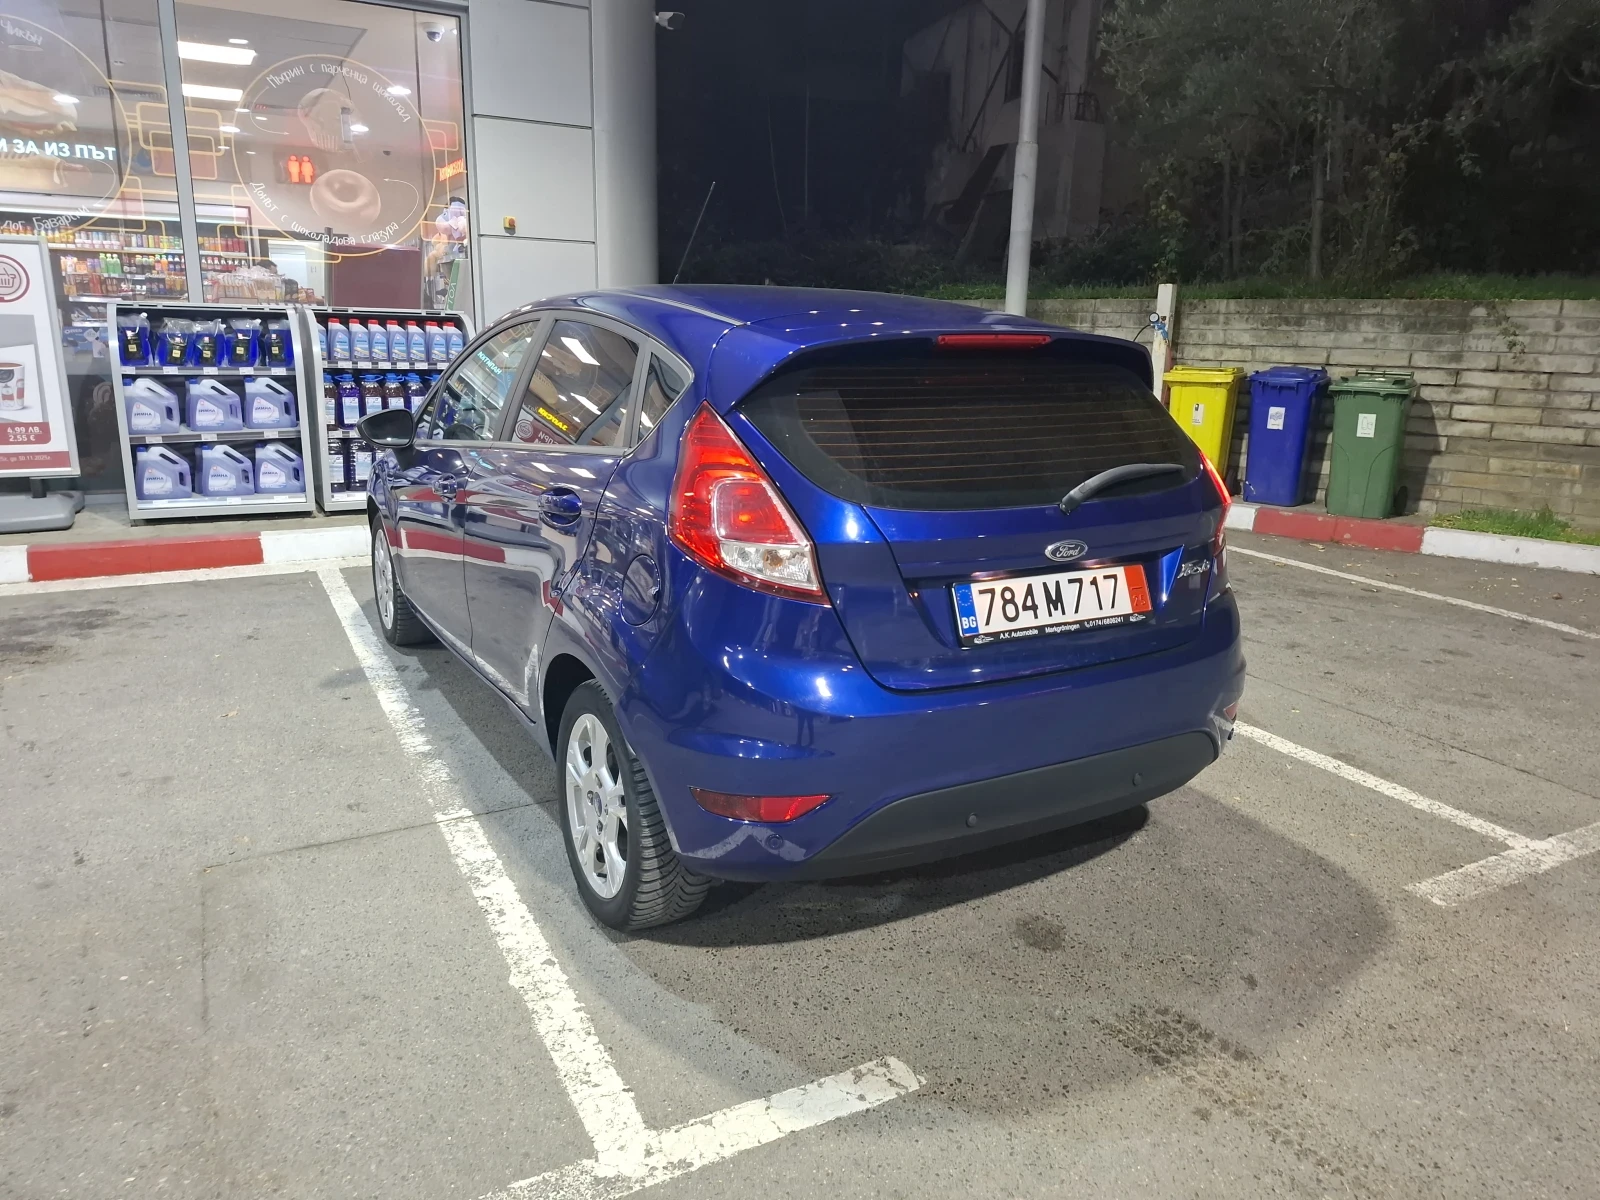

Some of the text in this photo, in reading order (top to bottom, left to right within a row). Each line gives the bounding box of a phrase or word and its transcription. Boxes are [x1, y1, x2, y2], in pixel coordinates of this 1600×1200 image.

[266, 64, 305, 88] Мъфин
[310, 63, 316, 73] с
[321, 63, 368, 84] парченца
[12, 139, 40, 154] ЗА
[44, 141, 71, 157] ИЗ
[75, 144, 117, 160] ПЪТ
[250, 181, 279, 212] Донът
[280, 214, 289, 222] с
[291, 221, 356, 246] шоколадова
[7, 426, 26, 434] 4.99
[9, 434, 36, 442] 2.55 €
[1056, 544, 1080, 557] Ford
[977, 573, 1119, 627] 784M717
[961, 616, 977, 629] BG
[1011, 628, 1039, 638] Automobile
